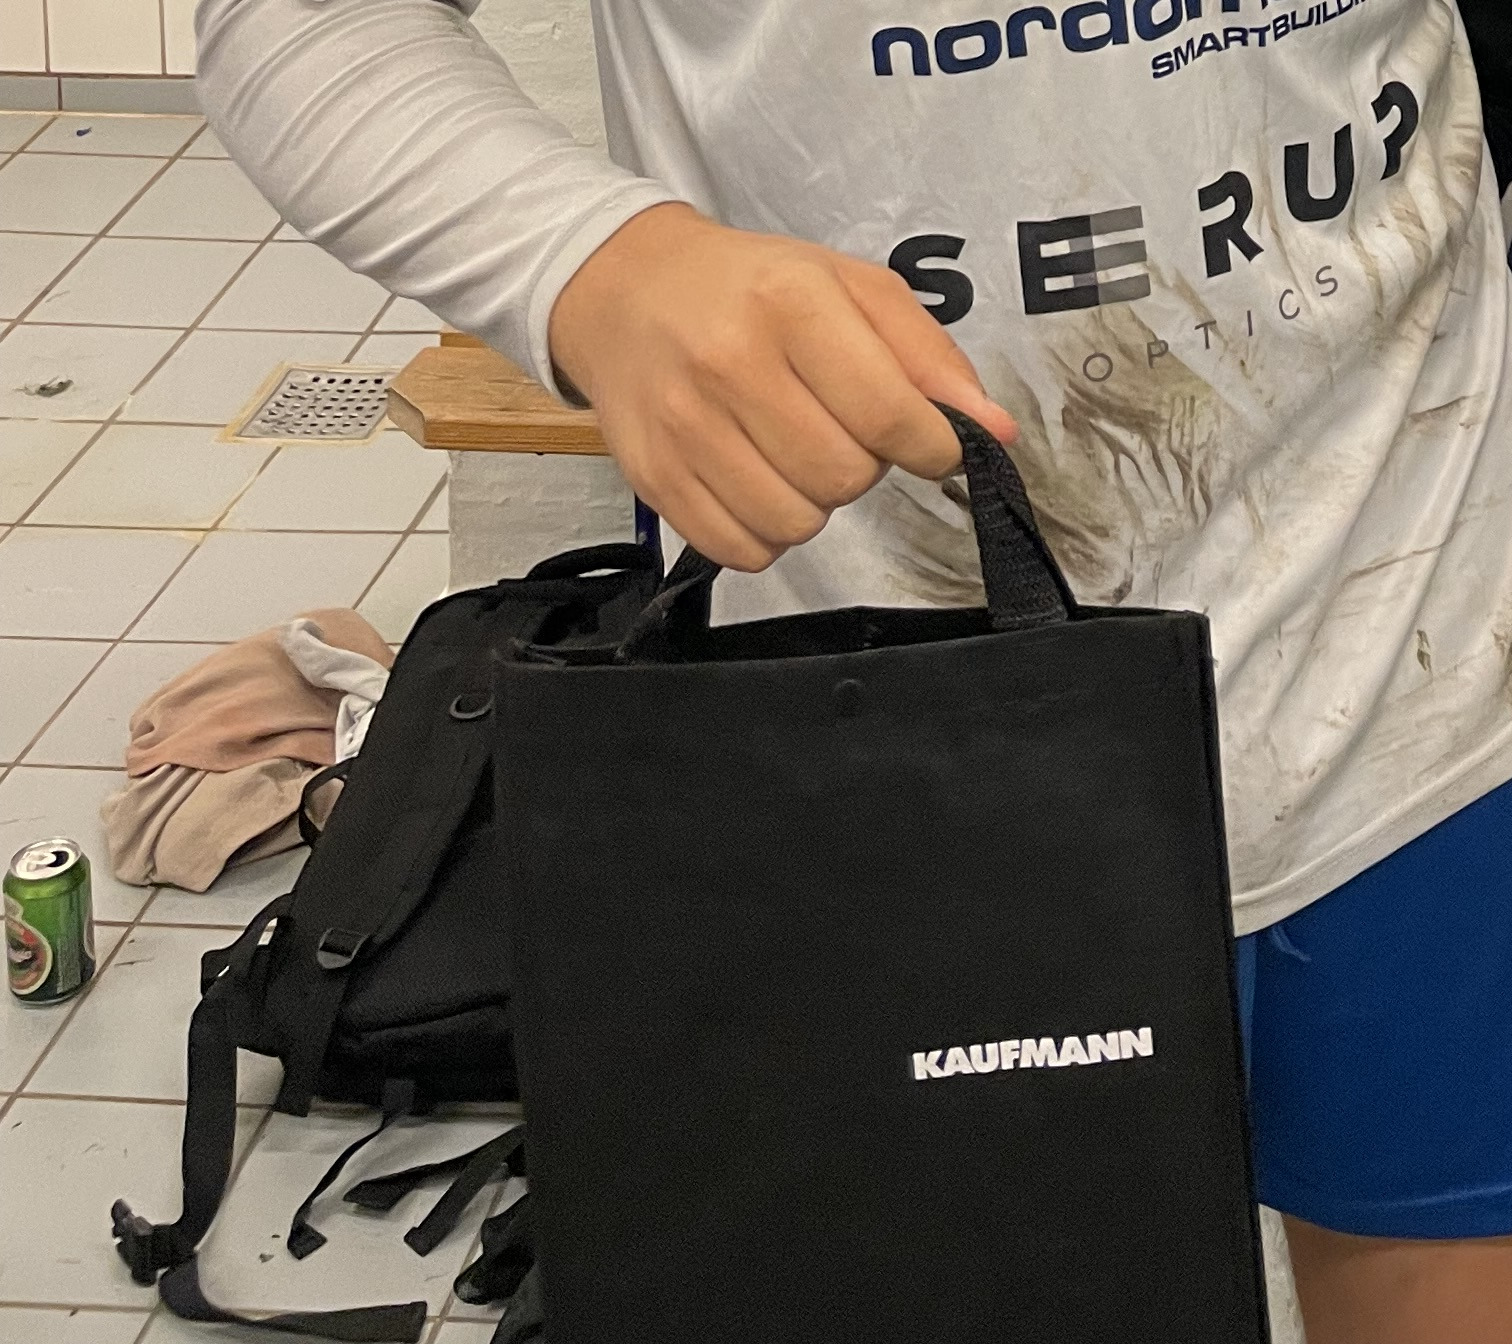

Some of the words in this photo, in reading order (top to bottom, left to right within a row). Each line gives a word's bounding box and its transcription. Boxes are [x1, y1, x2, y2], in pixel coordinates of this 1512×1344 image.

[886, 80, 1420, 327] SERUP
[1082, 264, 1339, 382] OPTICS
[912, 1026, 1154, 1081] KAUFMANN
